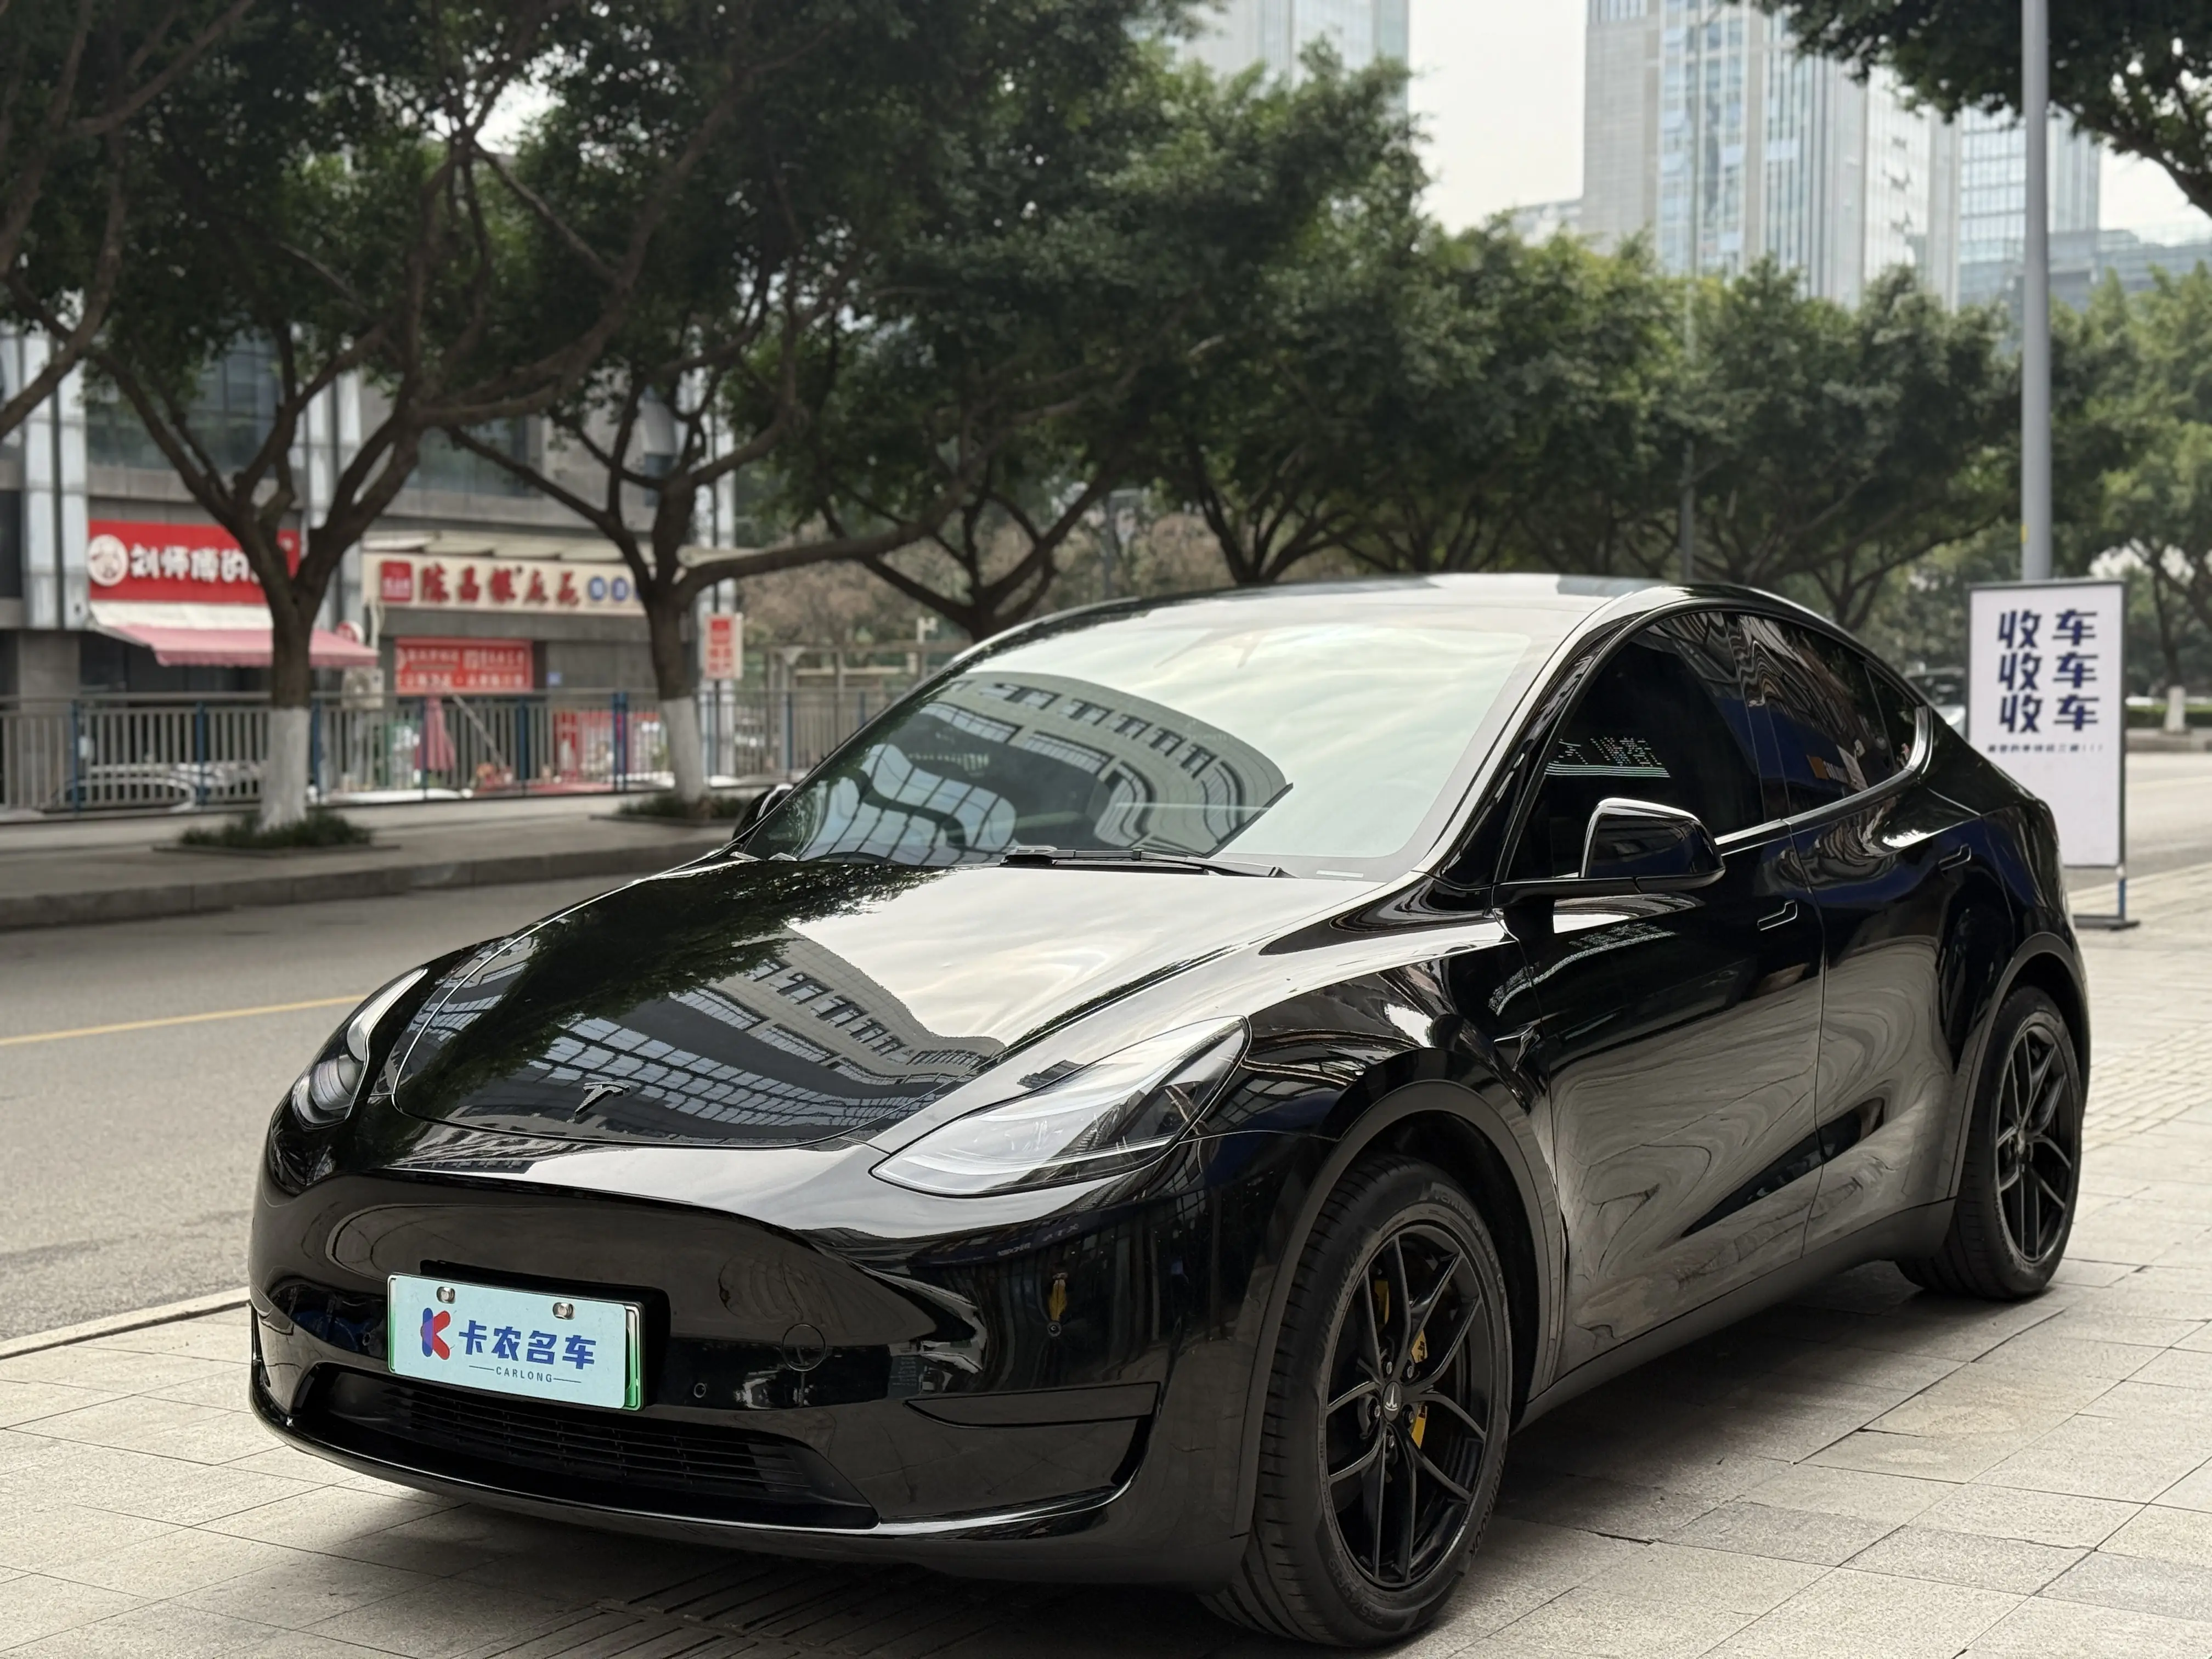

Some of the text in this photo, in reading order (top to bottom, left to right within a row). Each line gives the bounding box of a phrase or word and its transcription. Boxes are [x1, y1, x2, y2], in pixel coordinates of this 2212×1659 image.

[1997, 608, 2098, 649] 收车
[1998, 651, 2099, 691] 收车
[1999, 693, 2100, 733] 收车
[458, 1319, 597, 1370] 卡农名车
[495, 1365, 553, 1383] CARLONG
